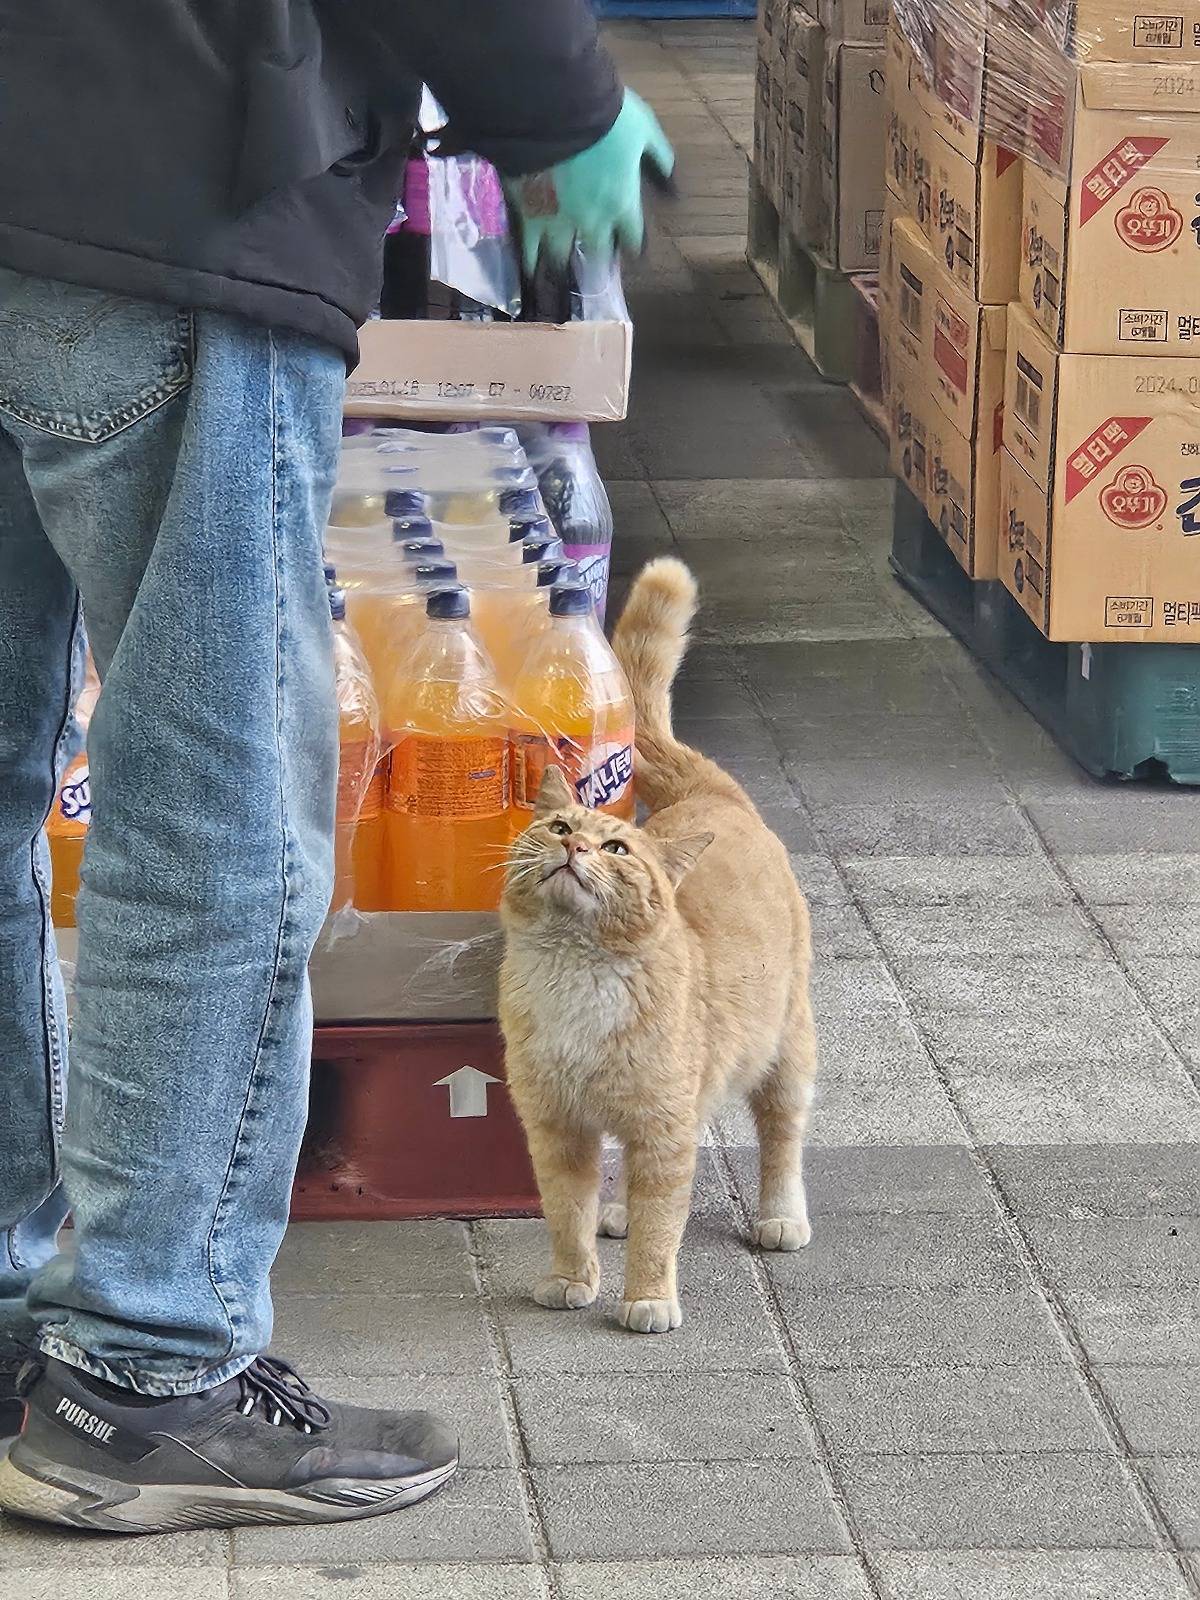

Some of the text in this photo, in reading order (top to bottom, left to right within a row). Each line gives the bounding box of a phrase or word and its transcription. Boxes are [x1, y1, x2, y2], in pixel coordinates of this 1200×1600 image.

[1127, 219, 1171, 238] 오뚜기
[1071, 421, 1128, 478] 멀티팩
[1112, 495, 1154, 513] 오뚜기
[1110, 600, 1148, 612] 소비기간
[55, 1397, 117, 1444] PURSUE
